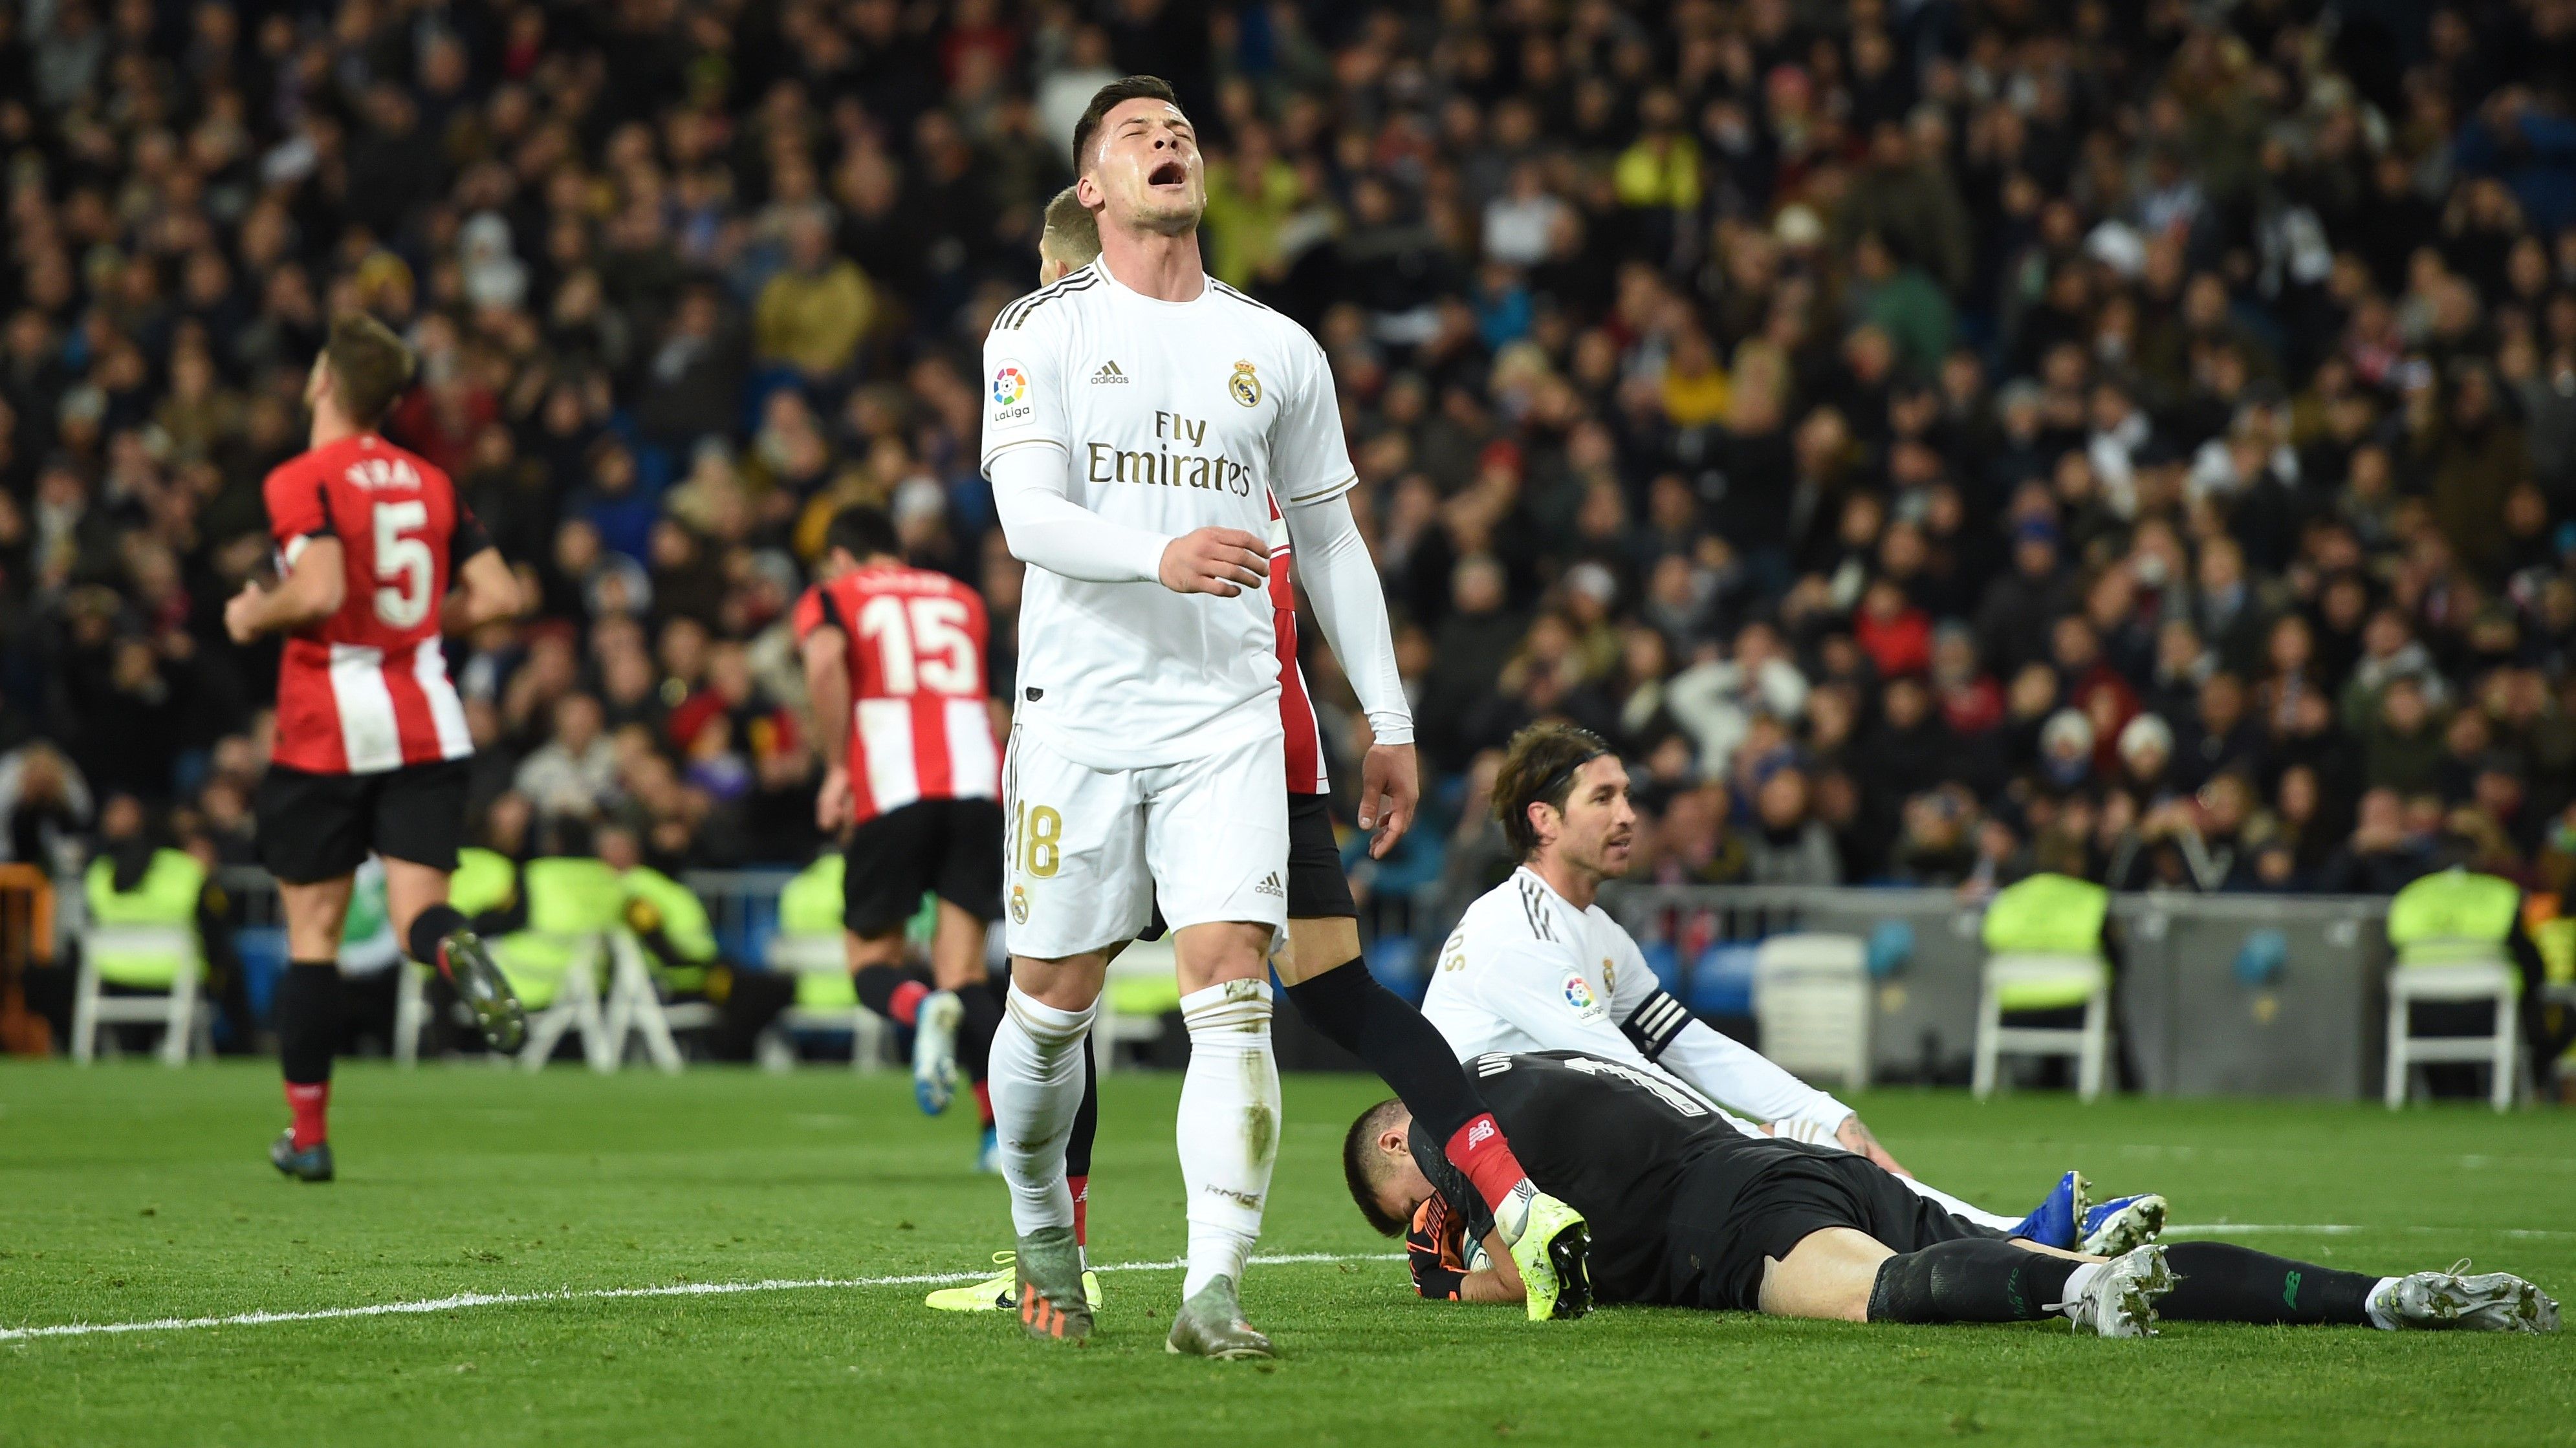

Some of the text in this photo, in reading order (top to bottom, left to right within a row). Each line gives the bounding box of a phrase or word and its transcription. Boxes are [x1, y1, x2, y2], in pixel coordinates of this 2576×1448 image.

[1091, 374, 1130, 384] adidas
[994, 406, 1031, 422] LaLiga
[1154, 410, 1206, 448] Fly
[1087, 442, 1251, 497] Emirates
[373, 499, 434, 630] 5
[858, 594, 979, 697] 15
[1016, 799, 1063, 879] 18
